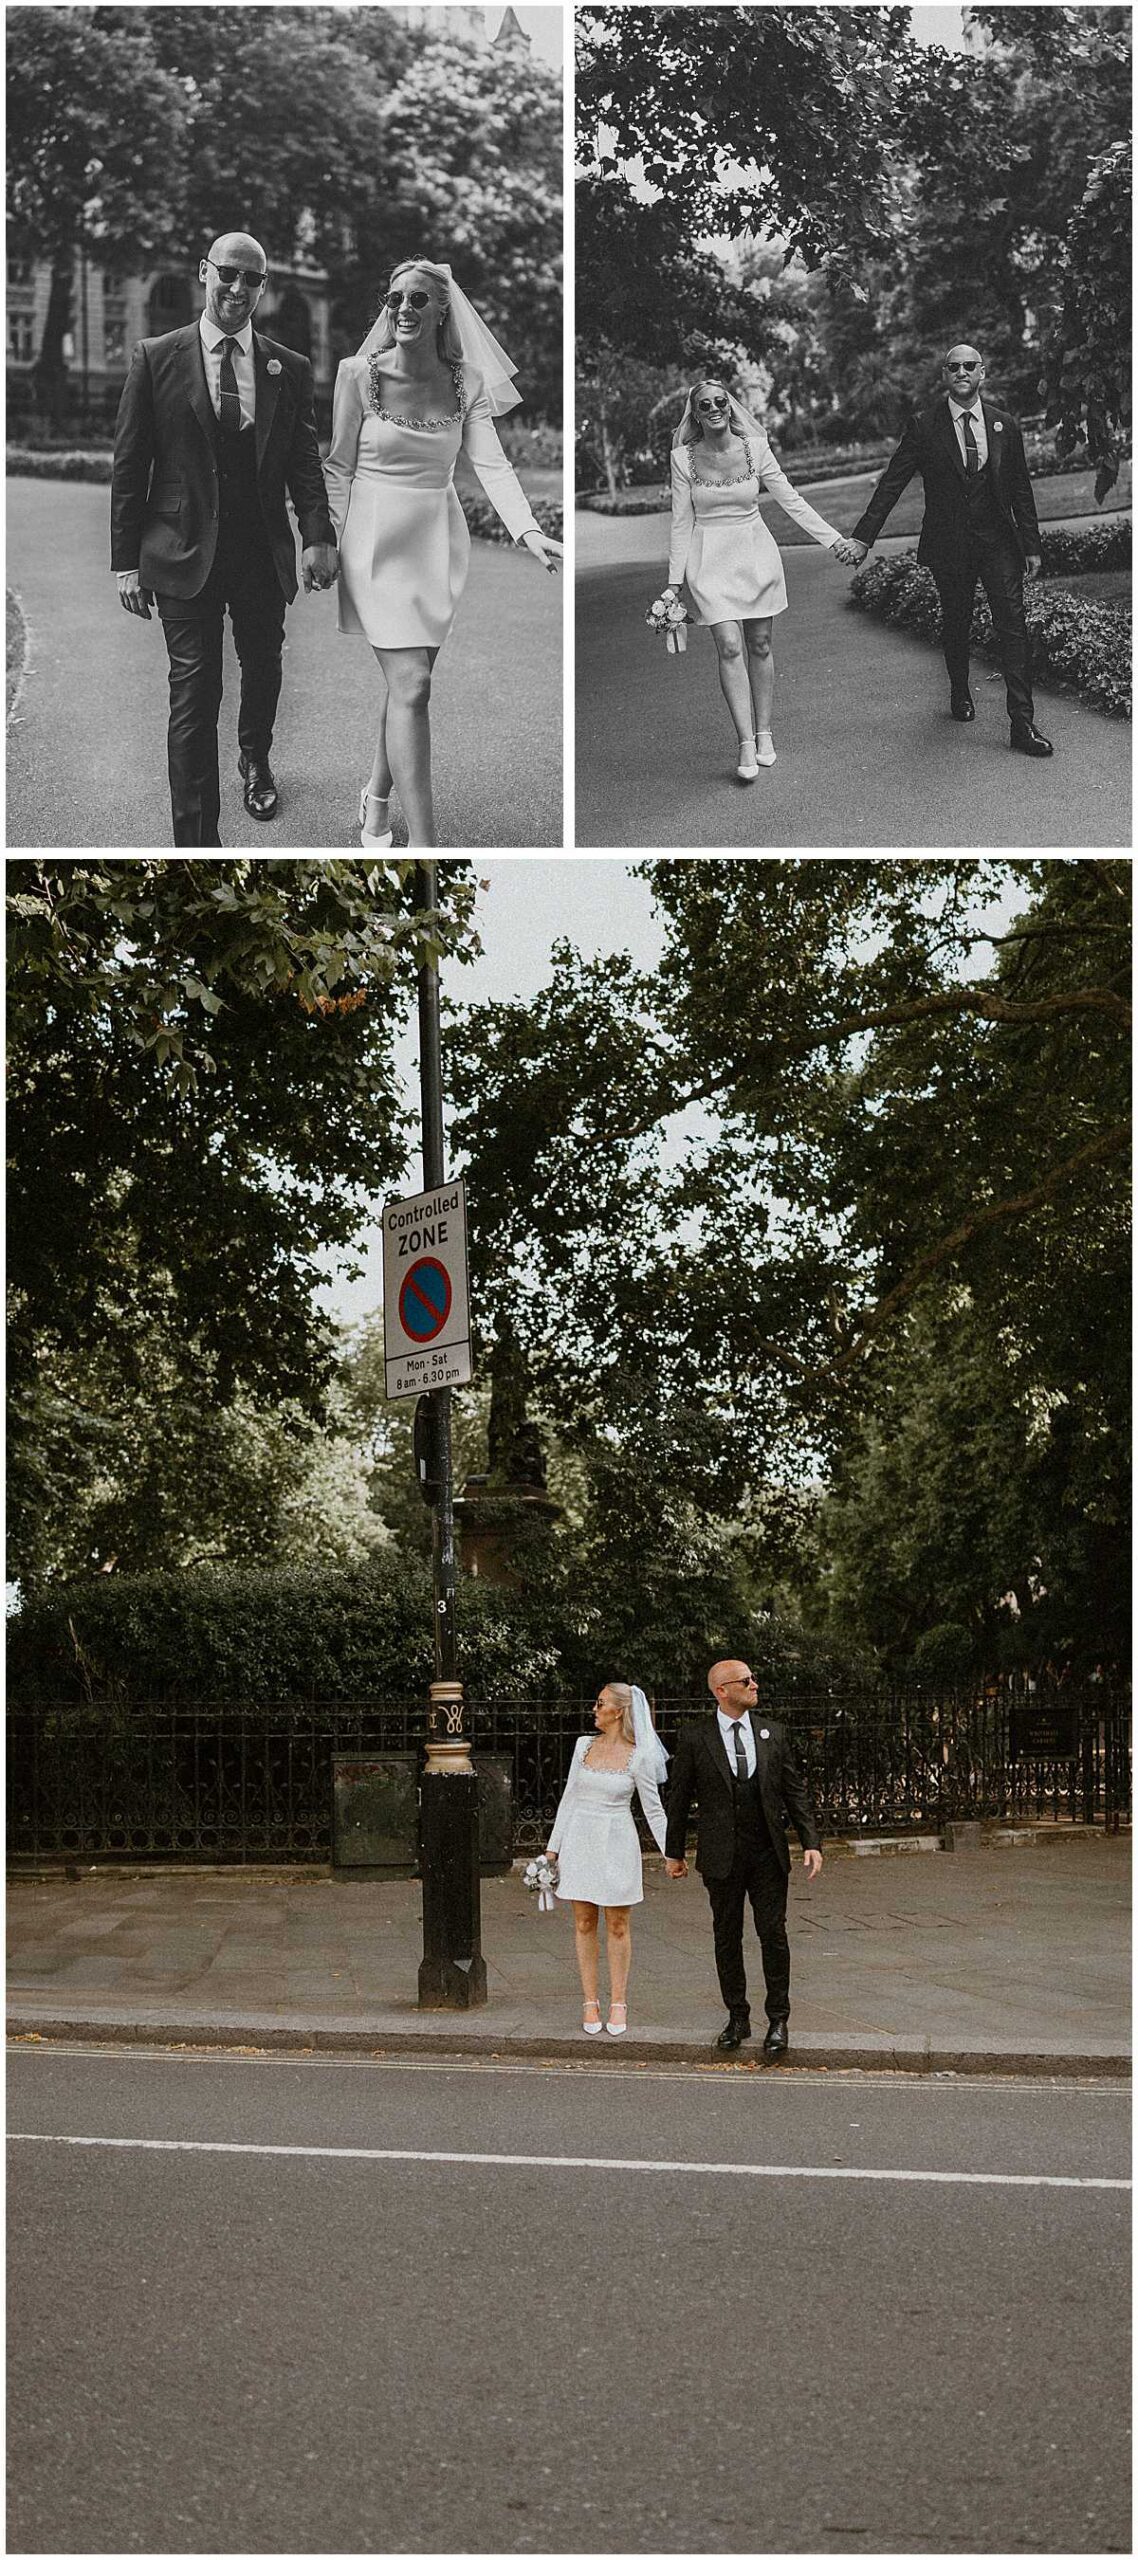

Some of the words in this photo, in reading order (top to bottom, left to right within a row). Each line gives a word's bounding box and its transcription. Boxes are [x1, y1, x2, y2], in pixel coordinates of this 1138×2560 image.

[388, 1190, 459, 1231] Controlled
[398, 1220, 449, 1257] ZONE
[406, 1360, 425, 1372] Mon
[431, 1352, 448, 1366] Sat
[396, 1378, 403, 1390] 8
[403, 1377, 417, 1389] am
[422, 1368, 444, 1384] 6.30
[445, 1367, 460, 1381] pm
[437, 1600, 448, 1614] 3
